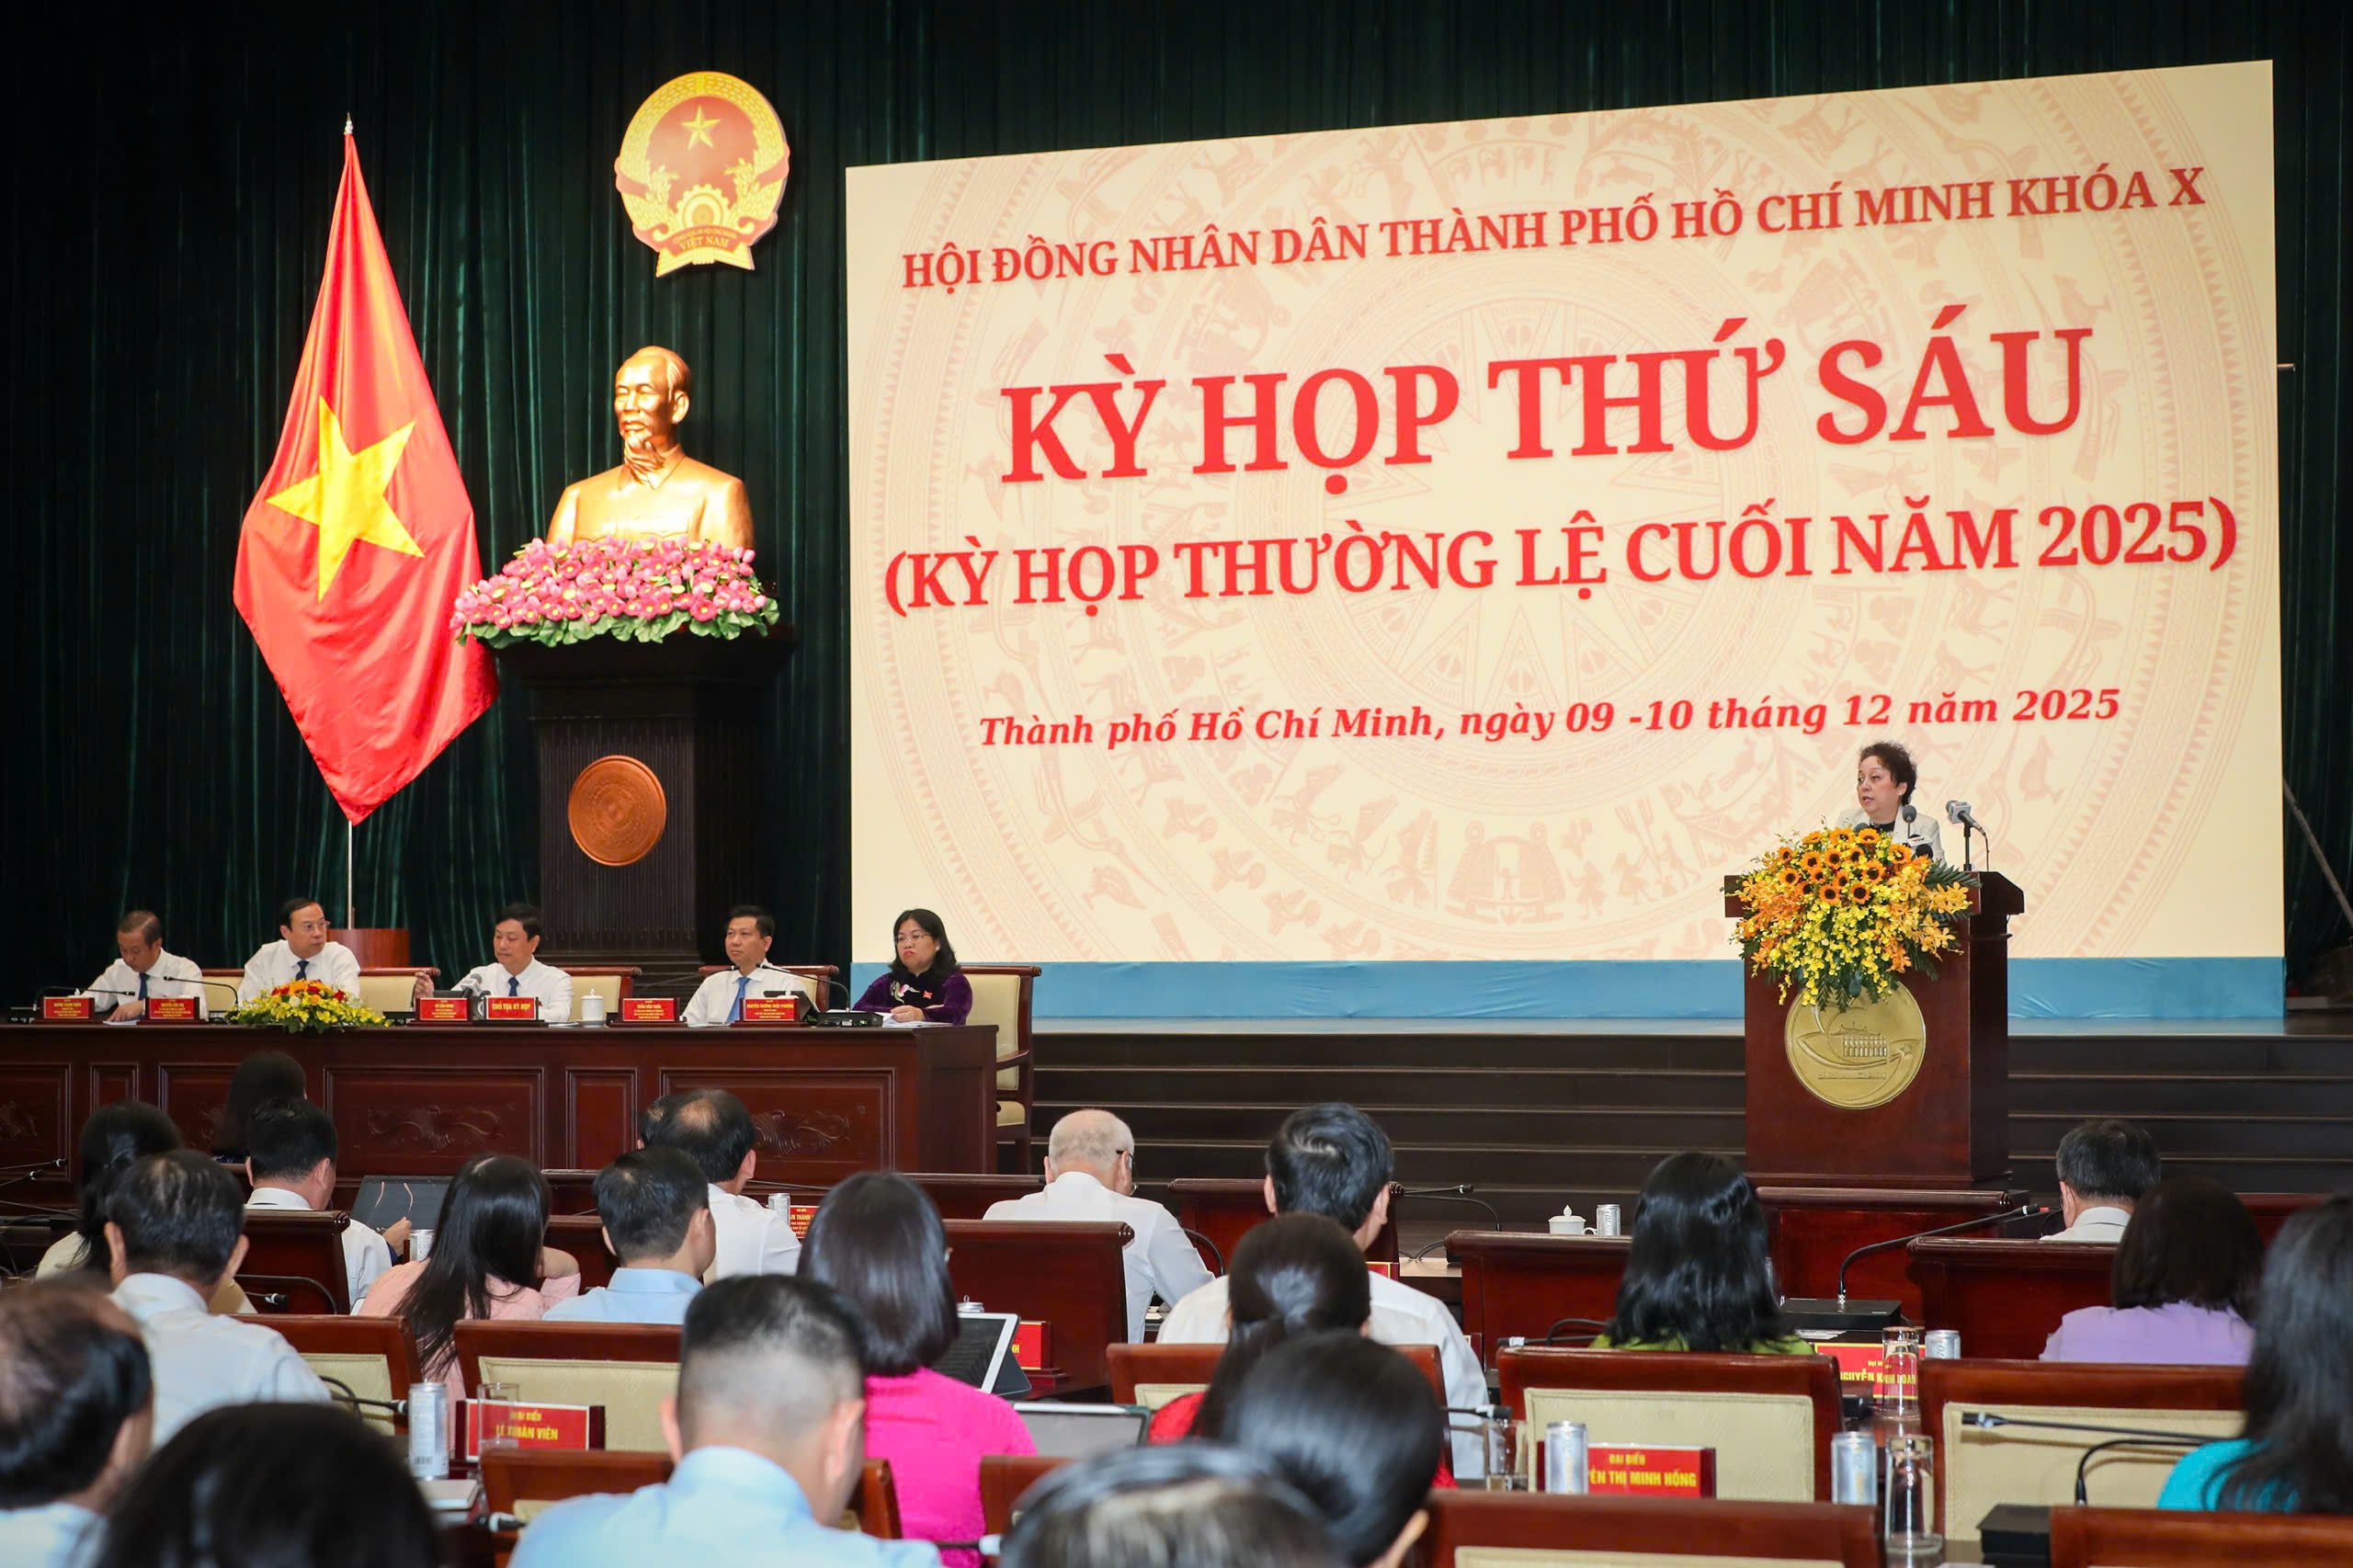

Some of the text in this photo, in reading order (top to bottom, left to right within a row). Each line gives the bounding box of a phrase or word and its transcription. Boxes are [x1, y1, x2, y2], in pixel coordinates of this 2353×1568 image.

[902, 163, 2205, 295] HỘI ĐỒNG NHÂN DÂN THÀNH PHỐ HỒ CHÍ MINH KHÓA X
[999, 303, 2093, 495] KỲ HỌP THỨ SÁU
[884, 494, 2237, 619] (KỲ HỌP THƯỜNG LỆ CUỐI NĂM 2025)
[979, 687, 2120, 751] Thành phố Hồ Chí Minh, ngày 09 -10 tháng 12 năm 2025
[1630, 1471, 1662, 1486] MINH
